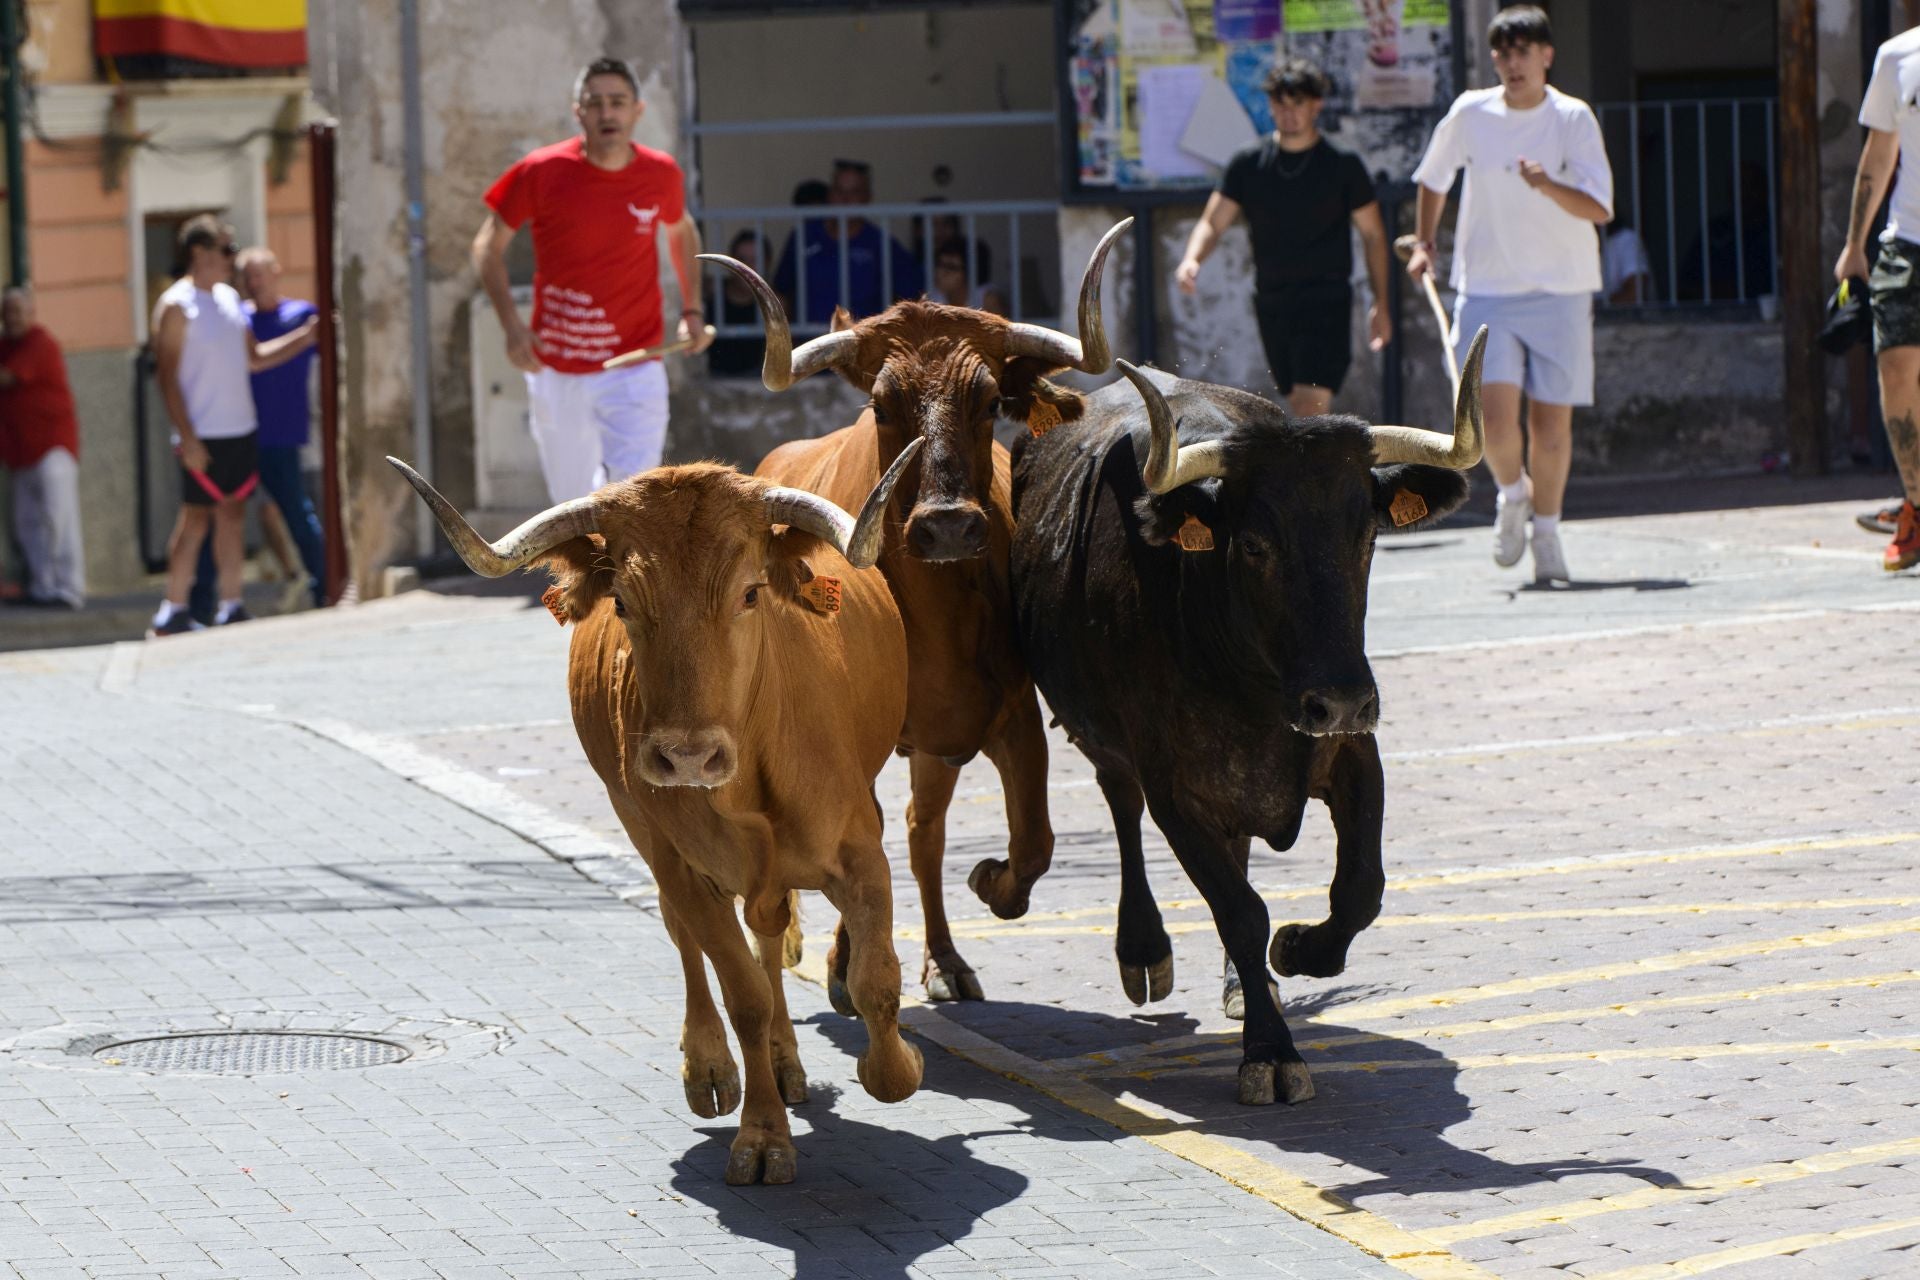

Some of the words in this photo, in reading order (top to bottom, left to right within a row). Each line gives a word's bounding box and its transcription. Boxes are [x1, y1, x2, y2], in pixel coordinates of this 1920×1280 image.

[1032, 414, 1061, 436] 5293
[1396, 503, 1426, 524] 4168
[825, 579, 841, 611] 8994
[543, 594, 569, 625] 8994
